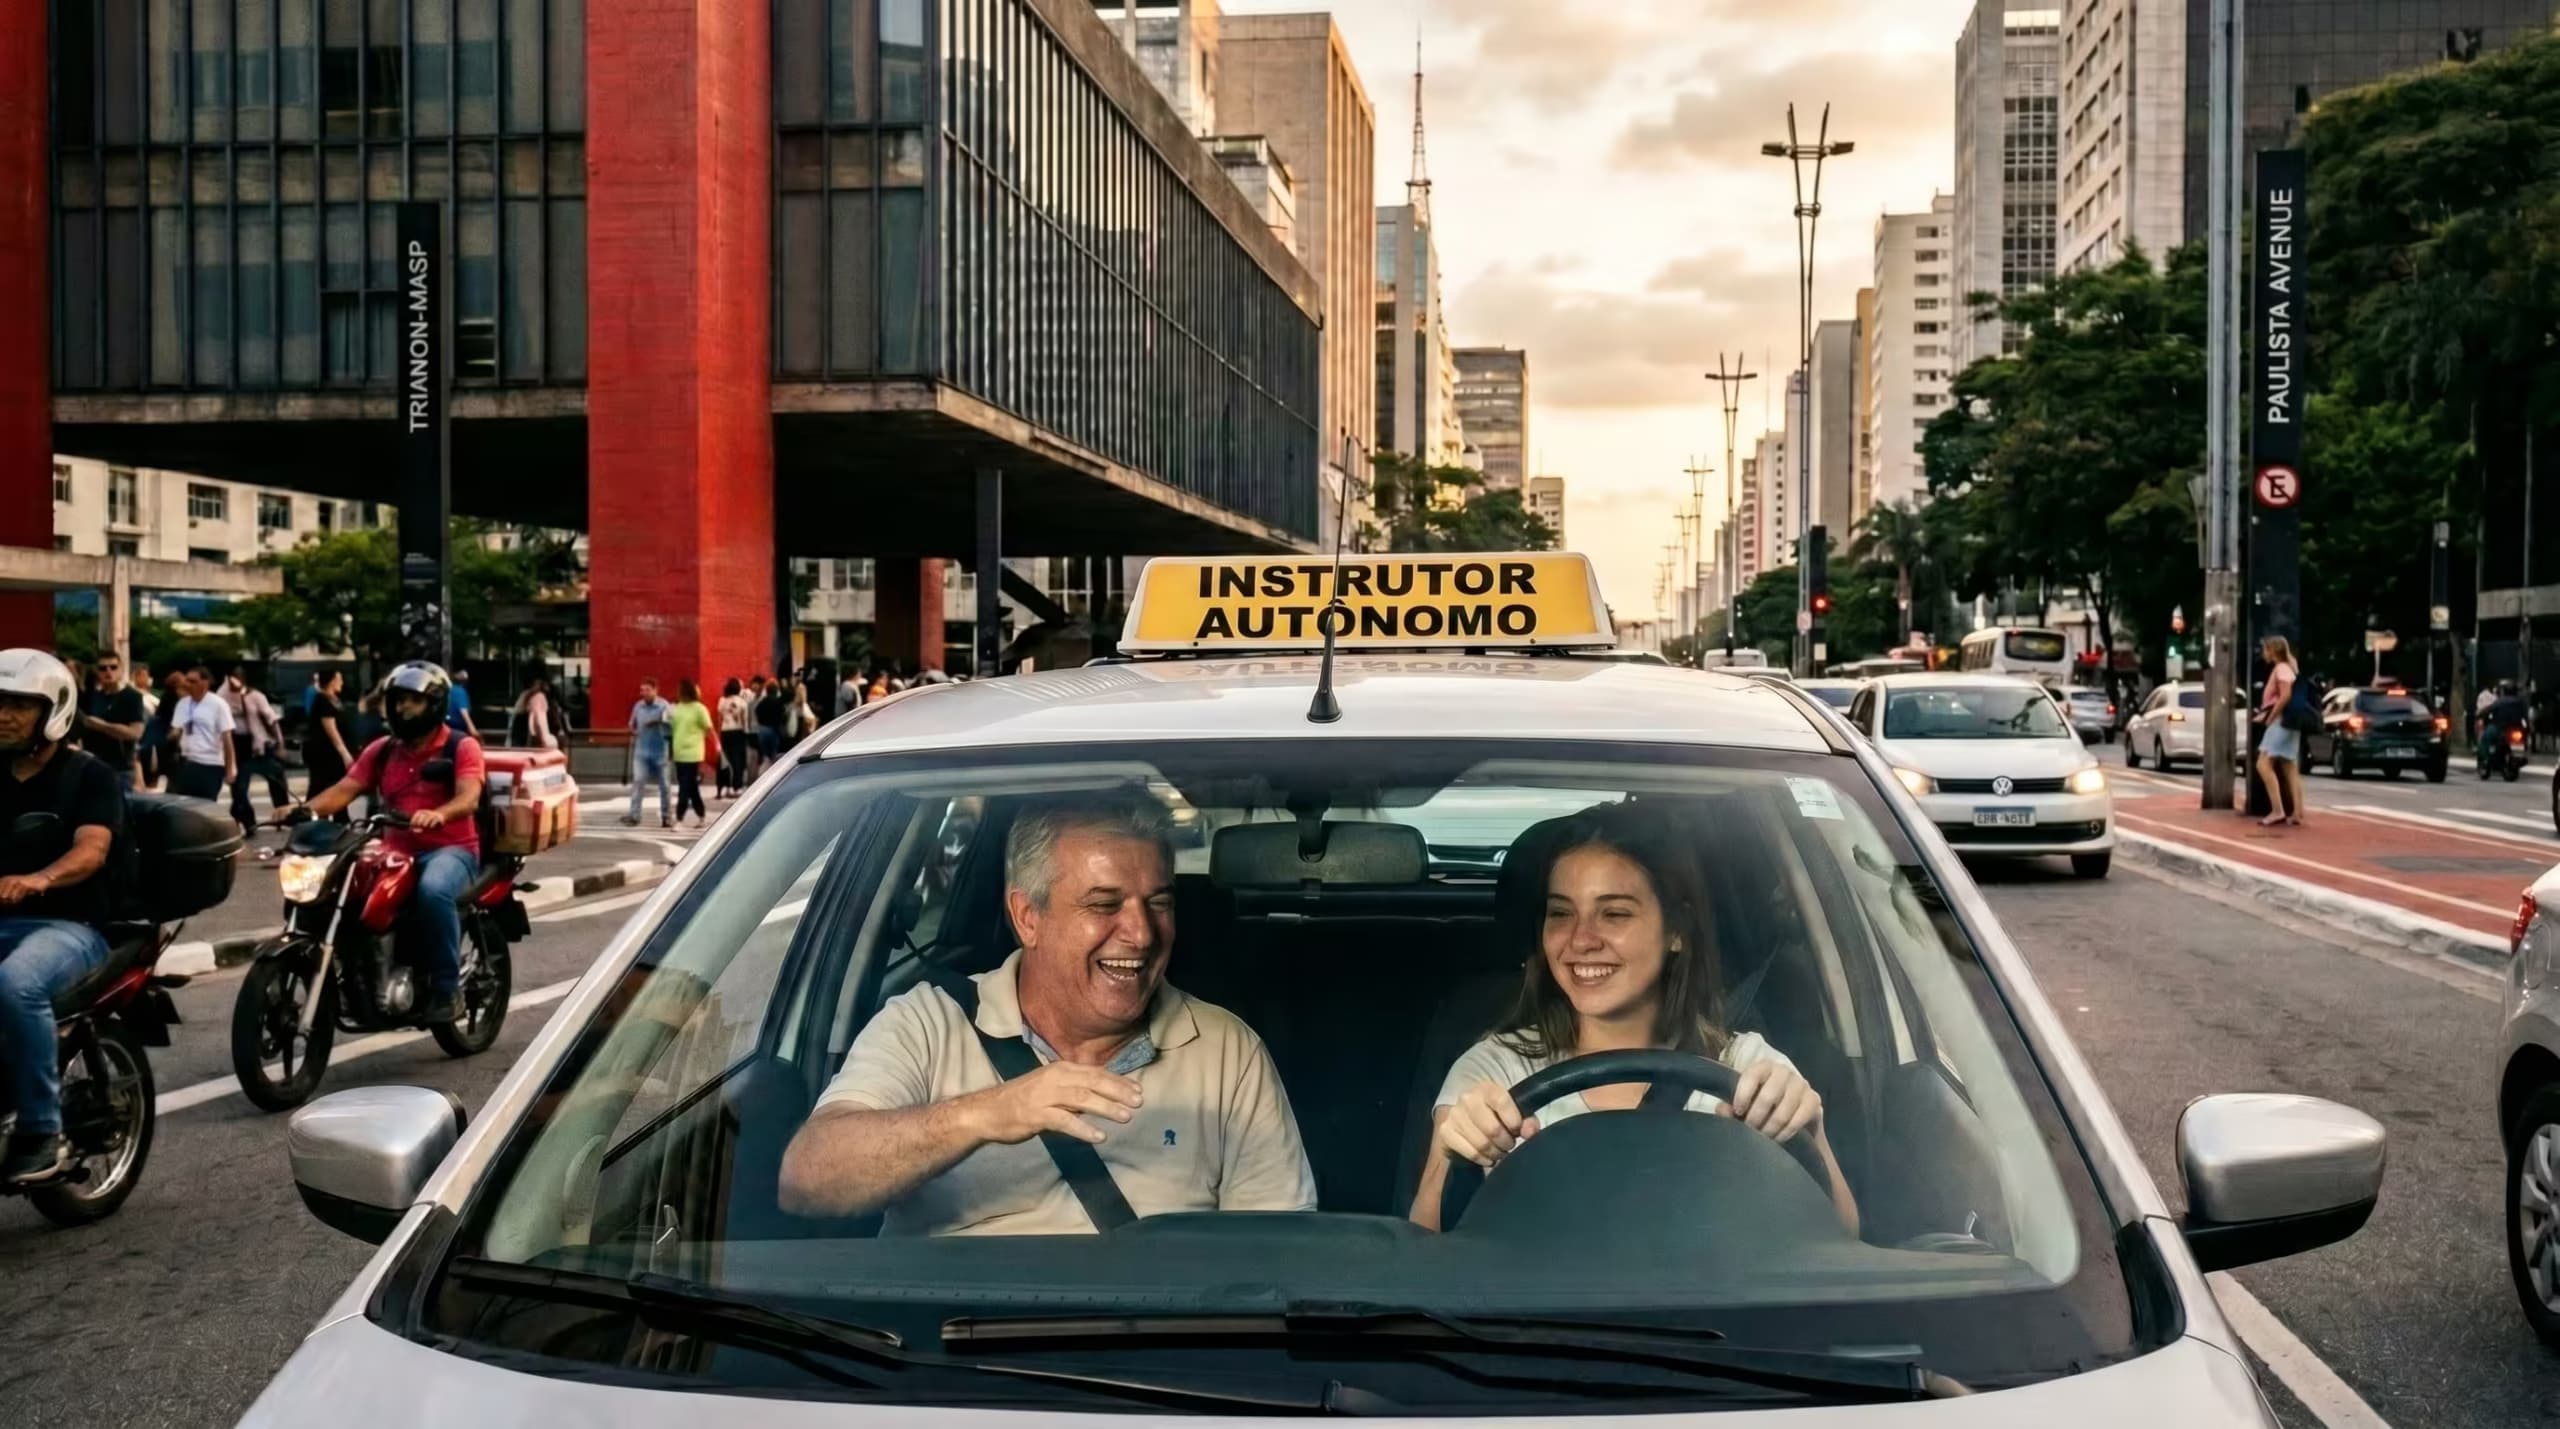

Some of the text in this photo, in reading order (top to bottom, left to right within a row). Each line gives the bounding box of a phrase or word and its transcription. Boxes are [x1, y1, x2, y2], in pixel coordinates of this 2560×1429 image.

[408, 240, 429, 434] TRIANON-MASP
[2267, 188, 2293, 423] PAULISTA AVENUE
[1195, 598, 1538, 639] AUTÔNOMO
[1199, 562, 1537, 598] INSTRUTOR
